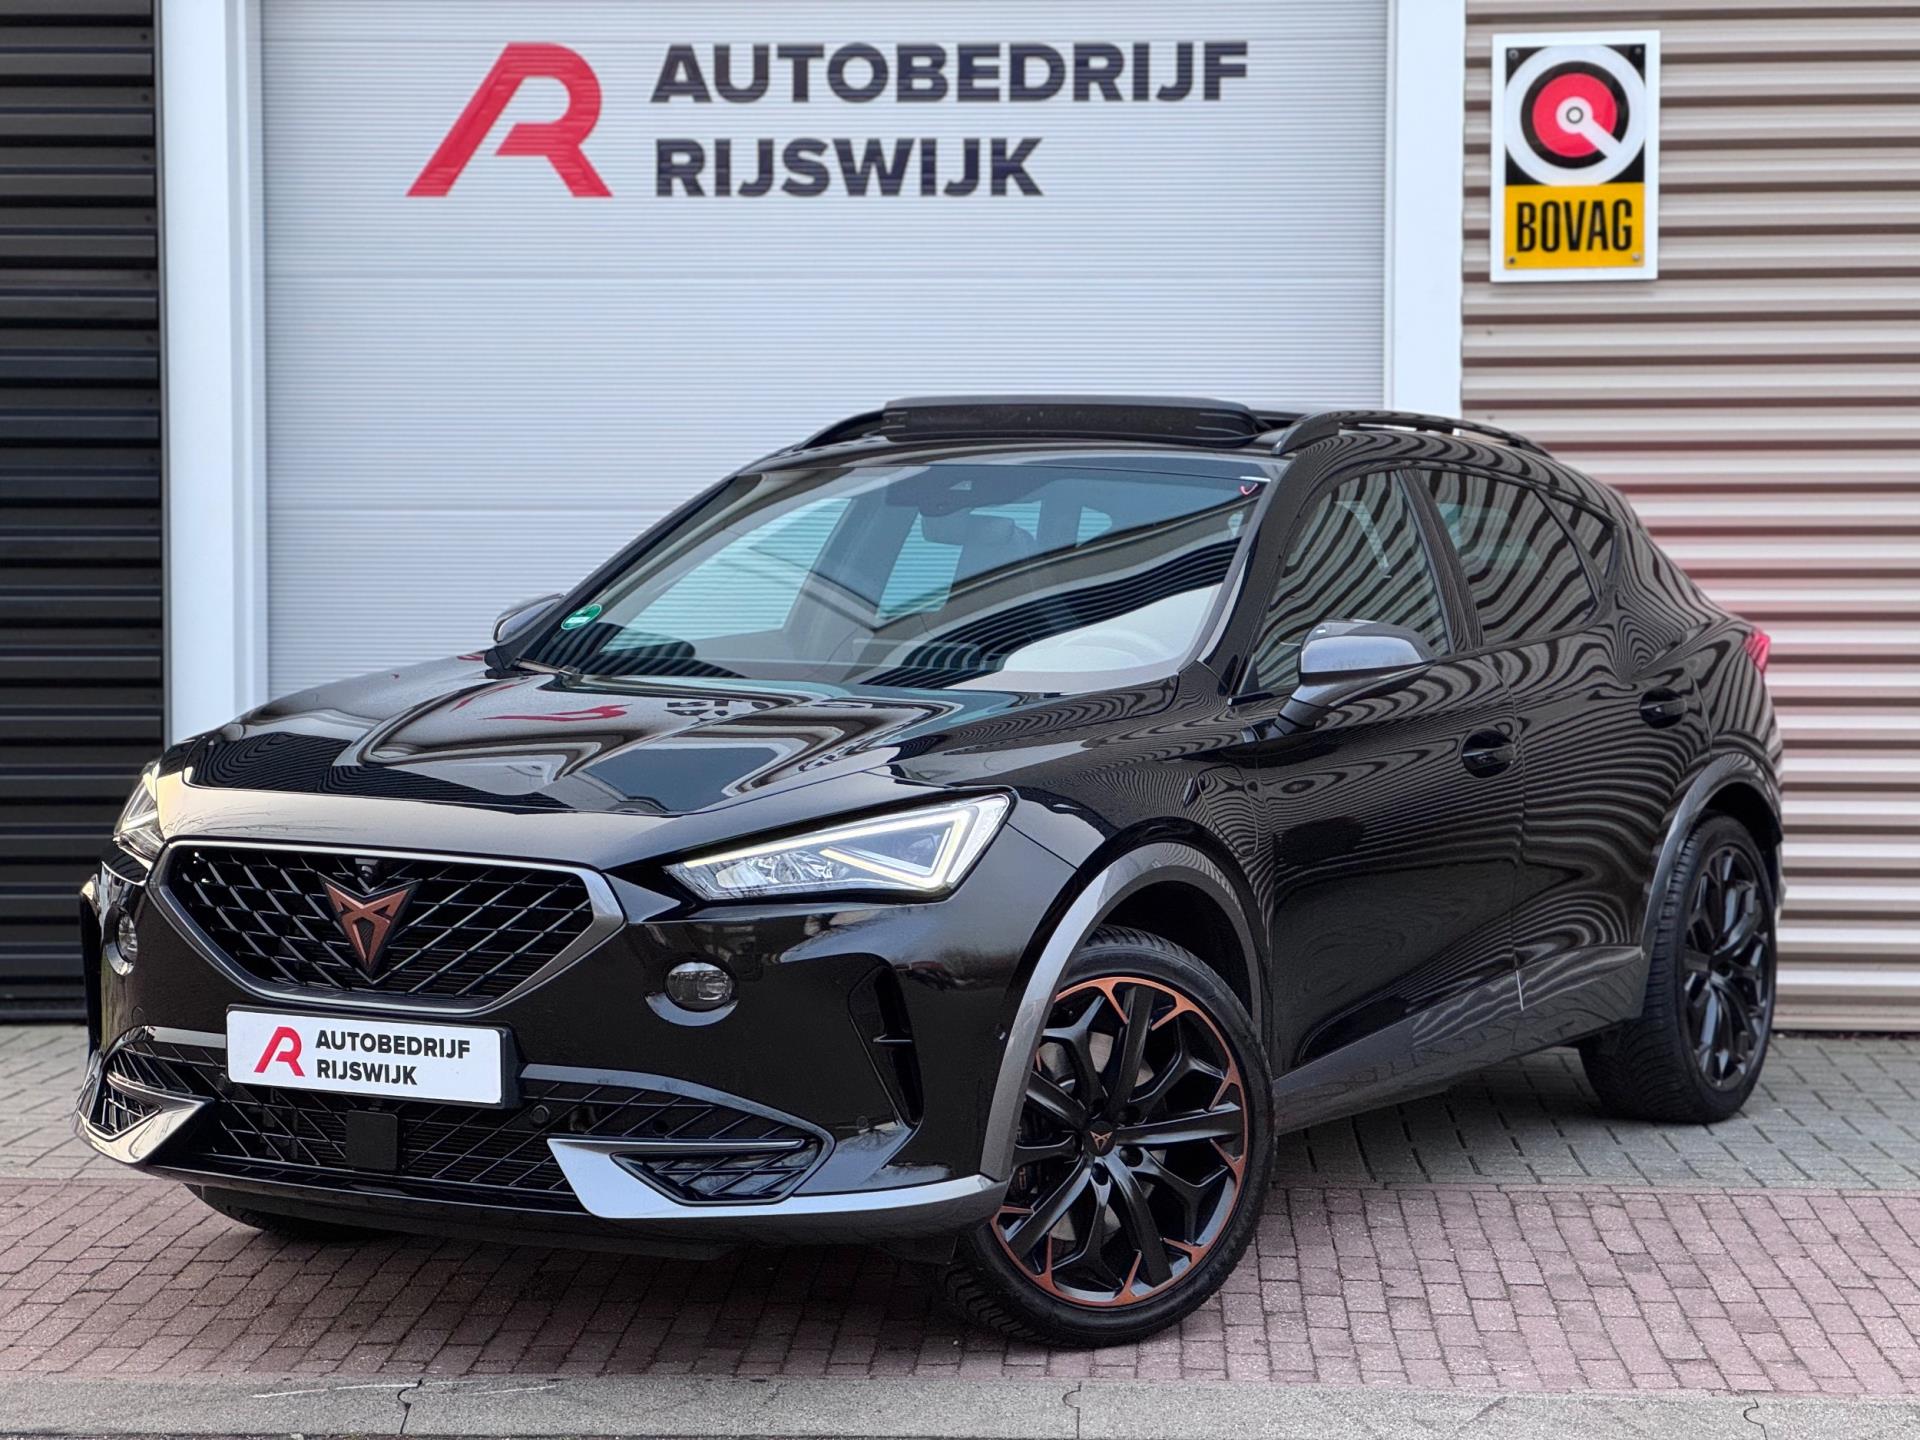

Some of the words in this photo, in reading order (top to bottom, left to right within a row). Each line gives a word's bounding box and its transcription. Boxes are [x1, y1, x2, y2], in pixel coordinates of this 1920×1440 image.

[651, 42, 1248, 103] AUTOBEDRIJF
[655, 137, 1043, 197] RIJSWIJK
[1516, 198, 1633, 253] BOVAG
[315, 1029, 470, 1059] AUTOBEDRIJF
[316, 1059, 418, 1085] RIJSWIJK
